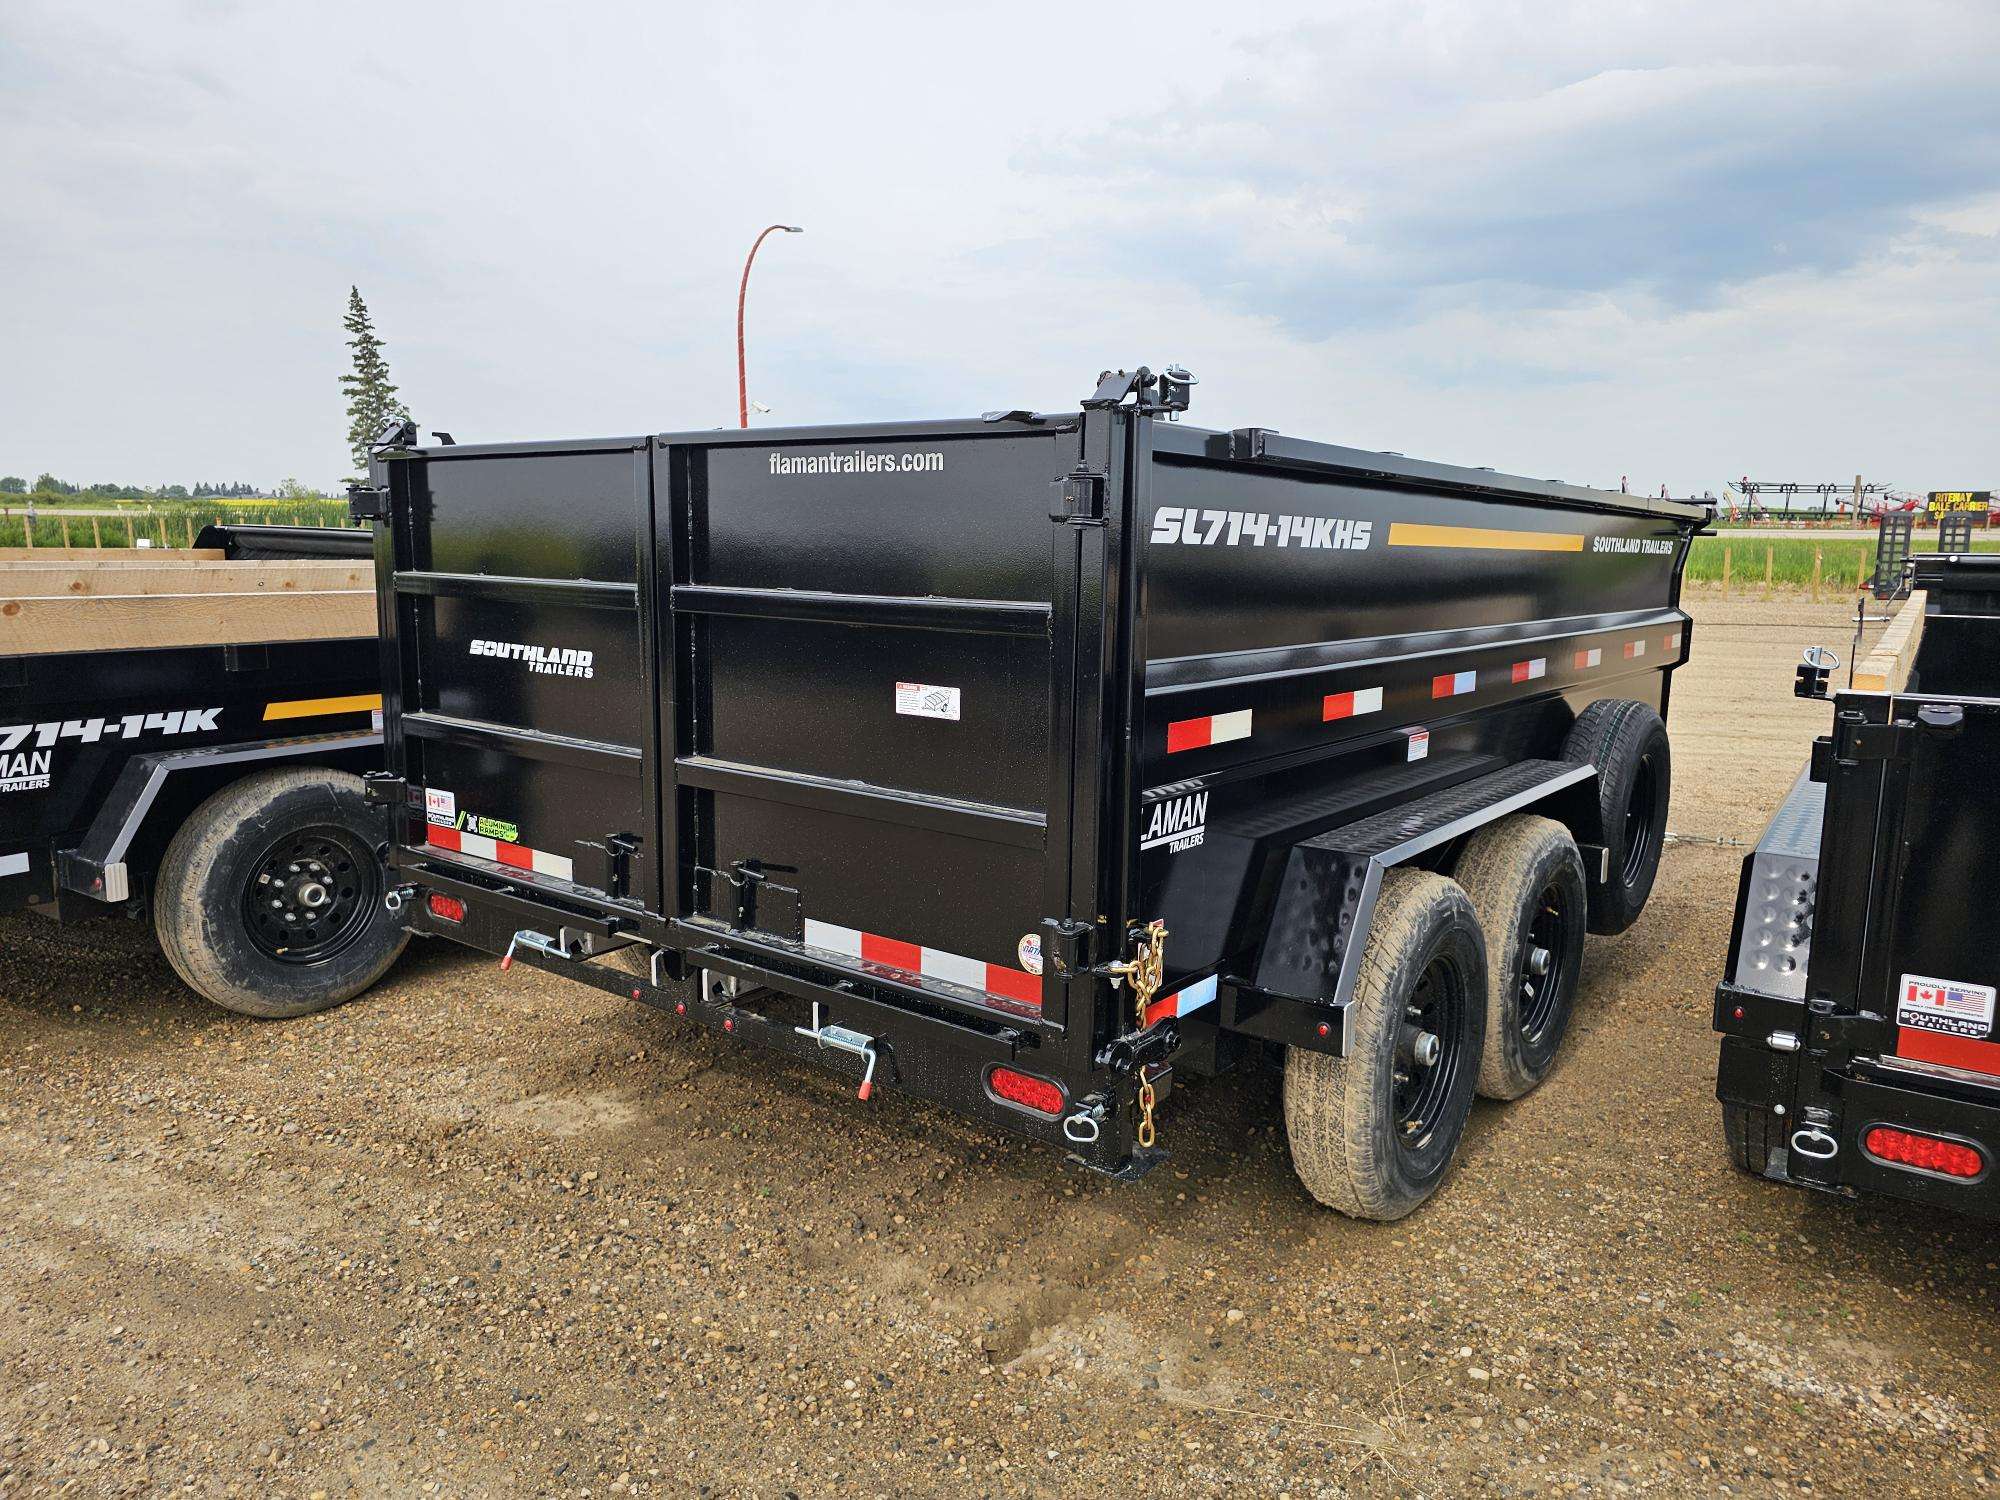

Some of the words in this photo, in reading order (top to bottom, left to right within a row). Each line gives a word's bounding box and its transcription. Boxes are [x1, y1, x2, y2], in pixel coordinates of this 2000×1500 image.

[769, 450, 944, 474] flamantrailers.com
[1935, 492, 1973, 502] RITEWAY
[1928, 501, 1951, 512] BALE
[1953, 501, 1989, 512] CARRIER
[1150, 506, 1373, 550] SL714-14KHS
[1592, 536, 1641, 553] SOUTHLAND
[1641, 539, 1674, 554] TRAILERS
[469, 639, 593, 667] SOUTHLAND
[528, 661, 594, 678] TRAILERS
[480, 817, 517, 833] ALUMINUM
[1169, 833, 1204, 854] TRAILERS
[1908, 981, 1947, 990] PROUDLY
[1949, 986, 1987, 997] SERVING
[1900, 1011, 1988, 1031] SOUTHLAND
[1909, 1019, 1978, 1035] TRAILERS
